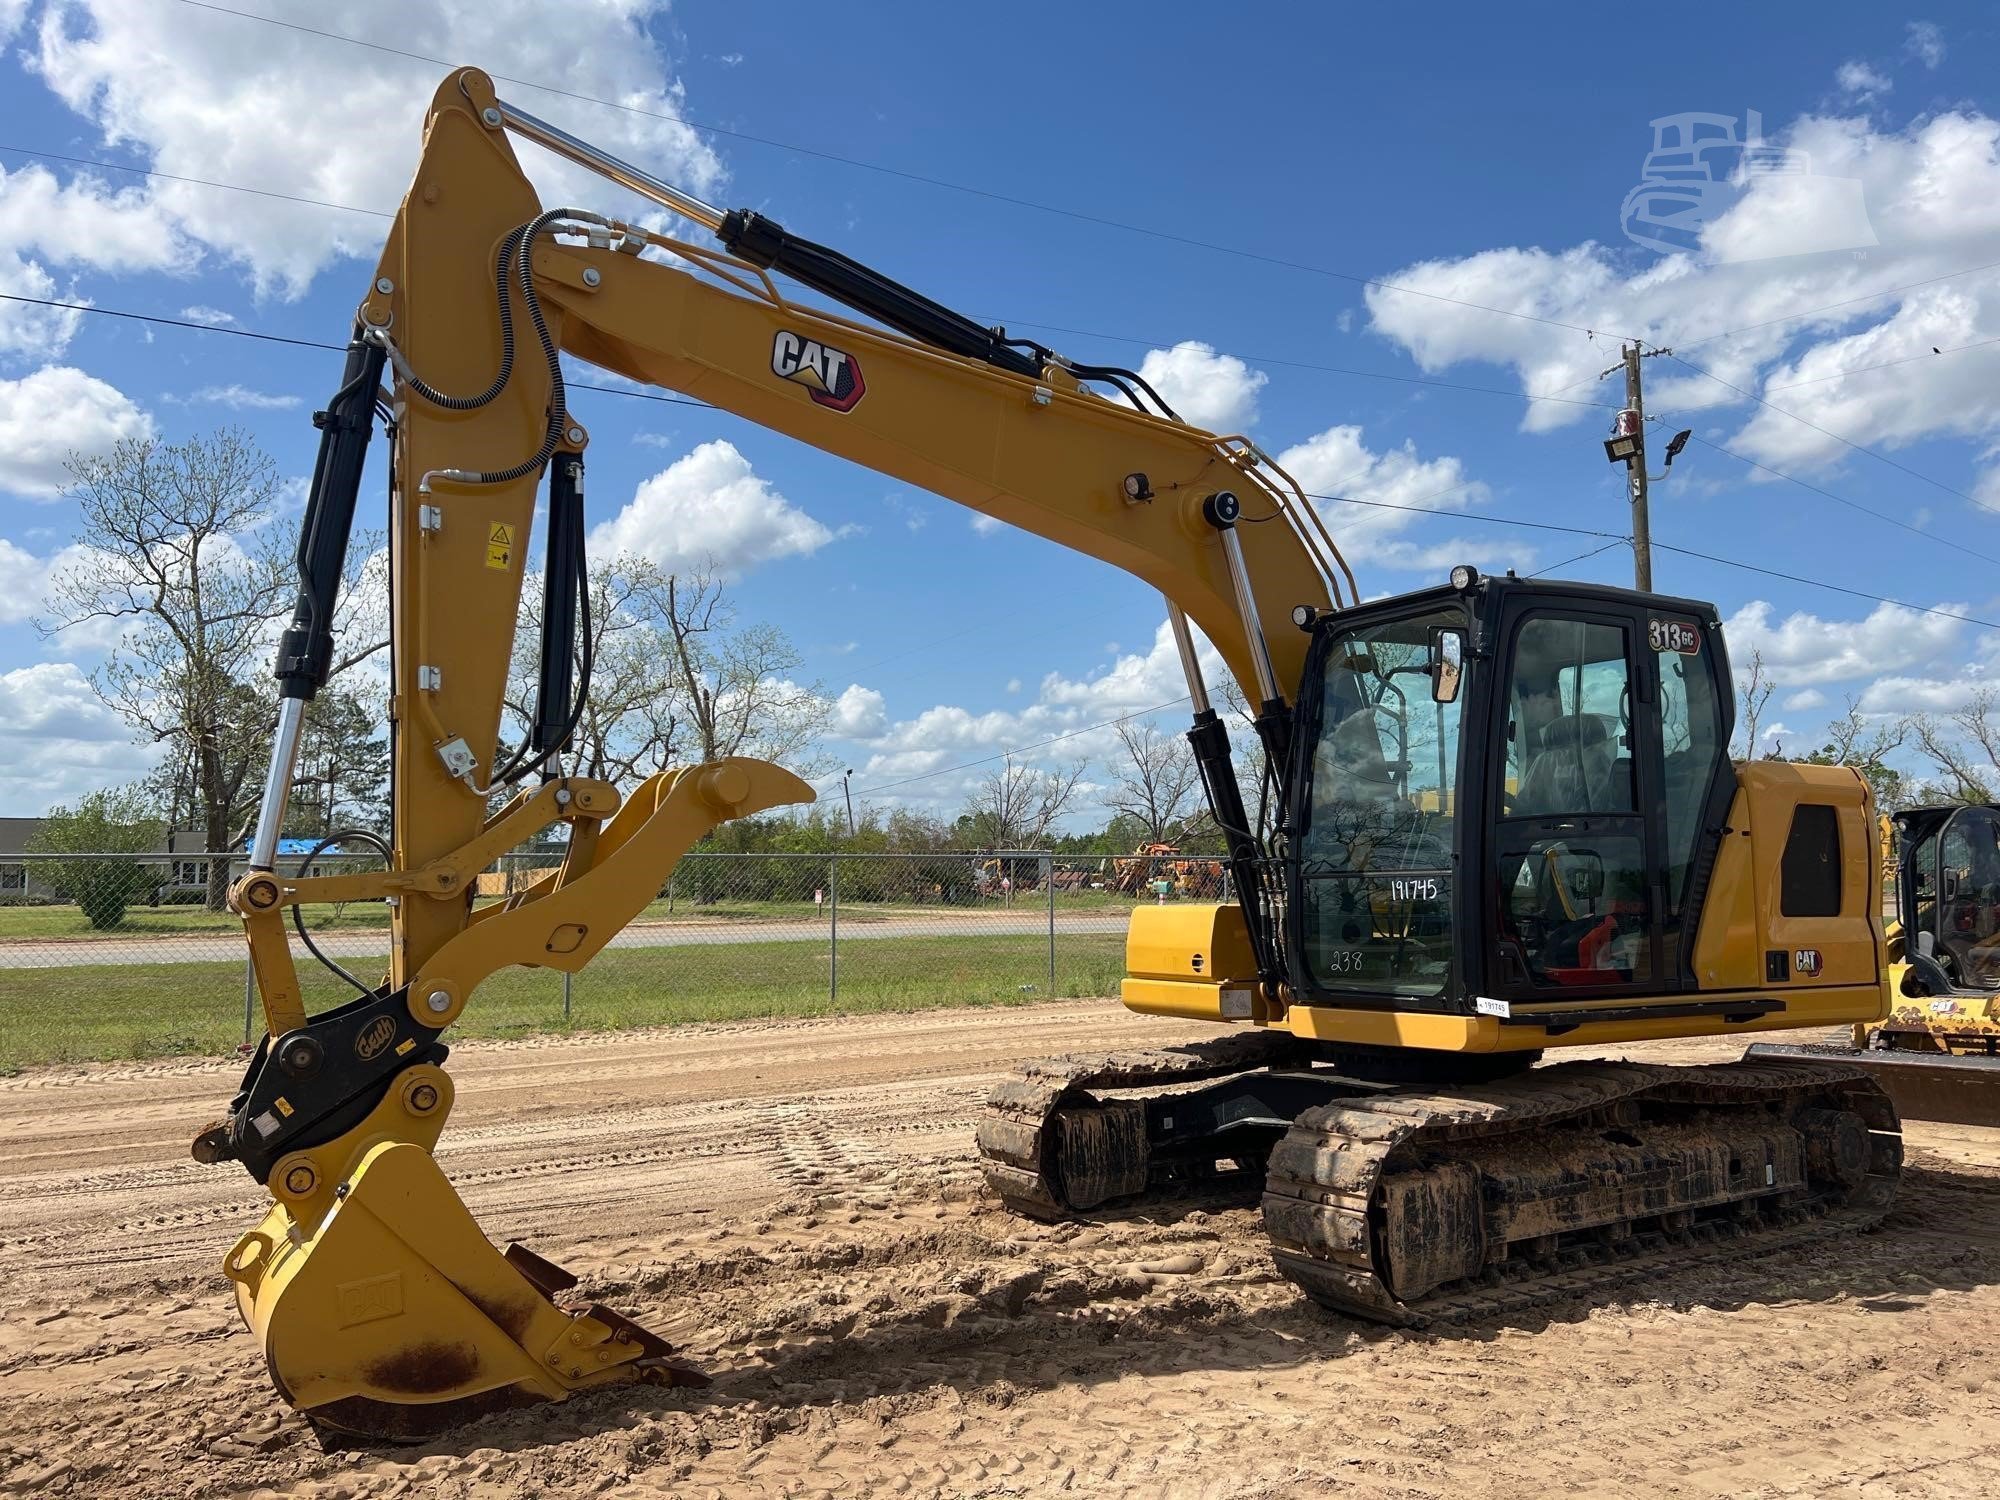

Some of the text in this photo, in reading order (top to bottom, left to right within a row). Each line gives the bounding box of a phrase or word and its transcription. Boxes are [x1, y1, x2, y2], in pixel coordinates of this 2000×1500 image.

[773, 332, 846, 394] CAT
[1650, 621, 1681, 650] 313
[1392, 879, 1437, 901] 191745
[1331, 951, 1363, 972] 238
[1796, 950, 1816, 971] CAT
